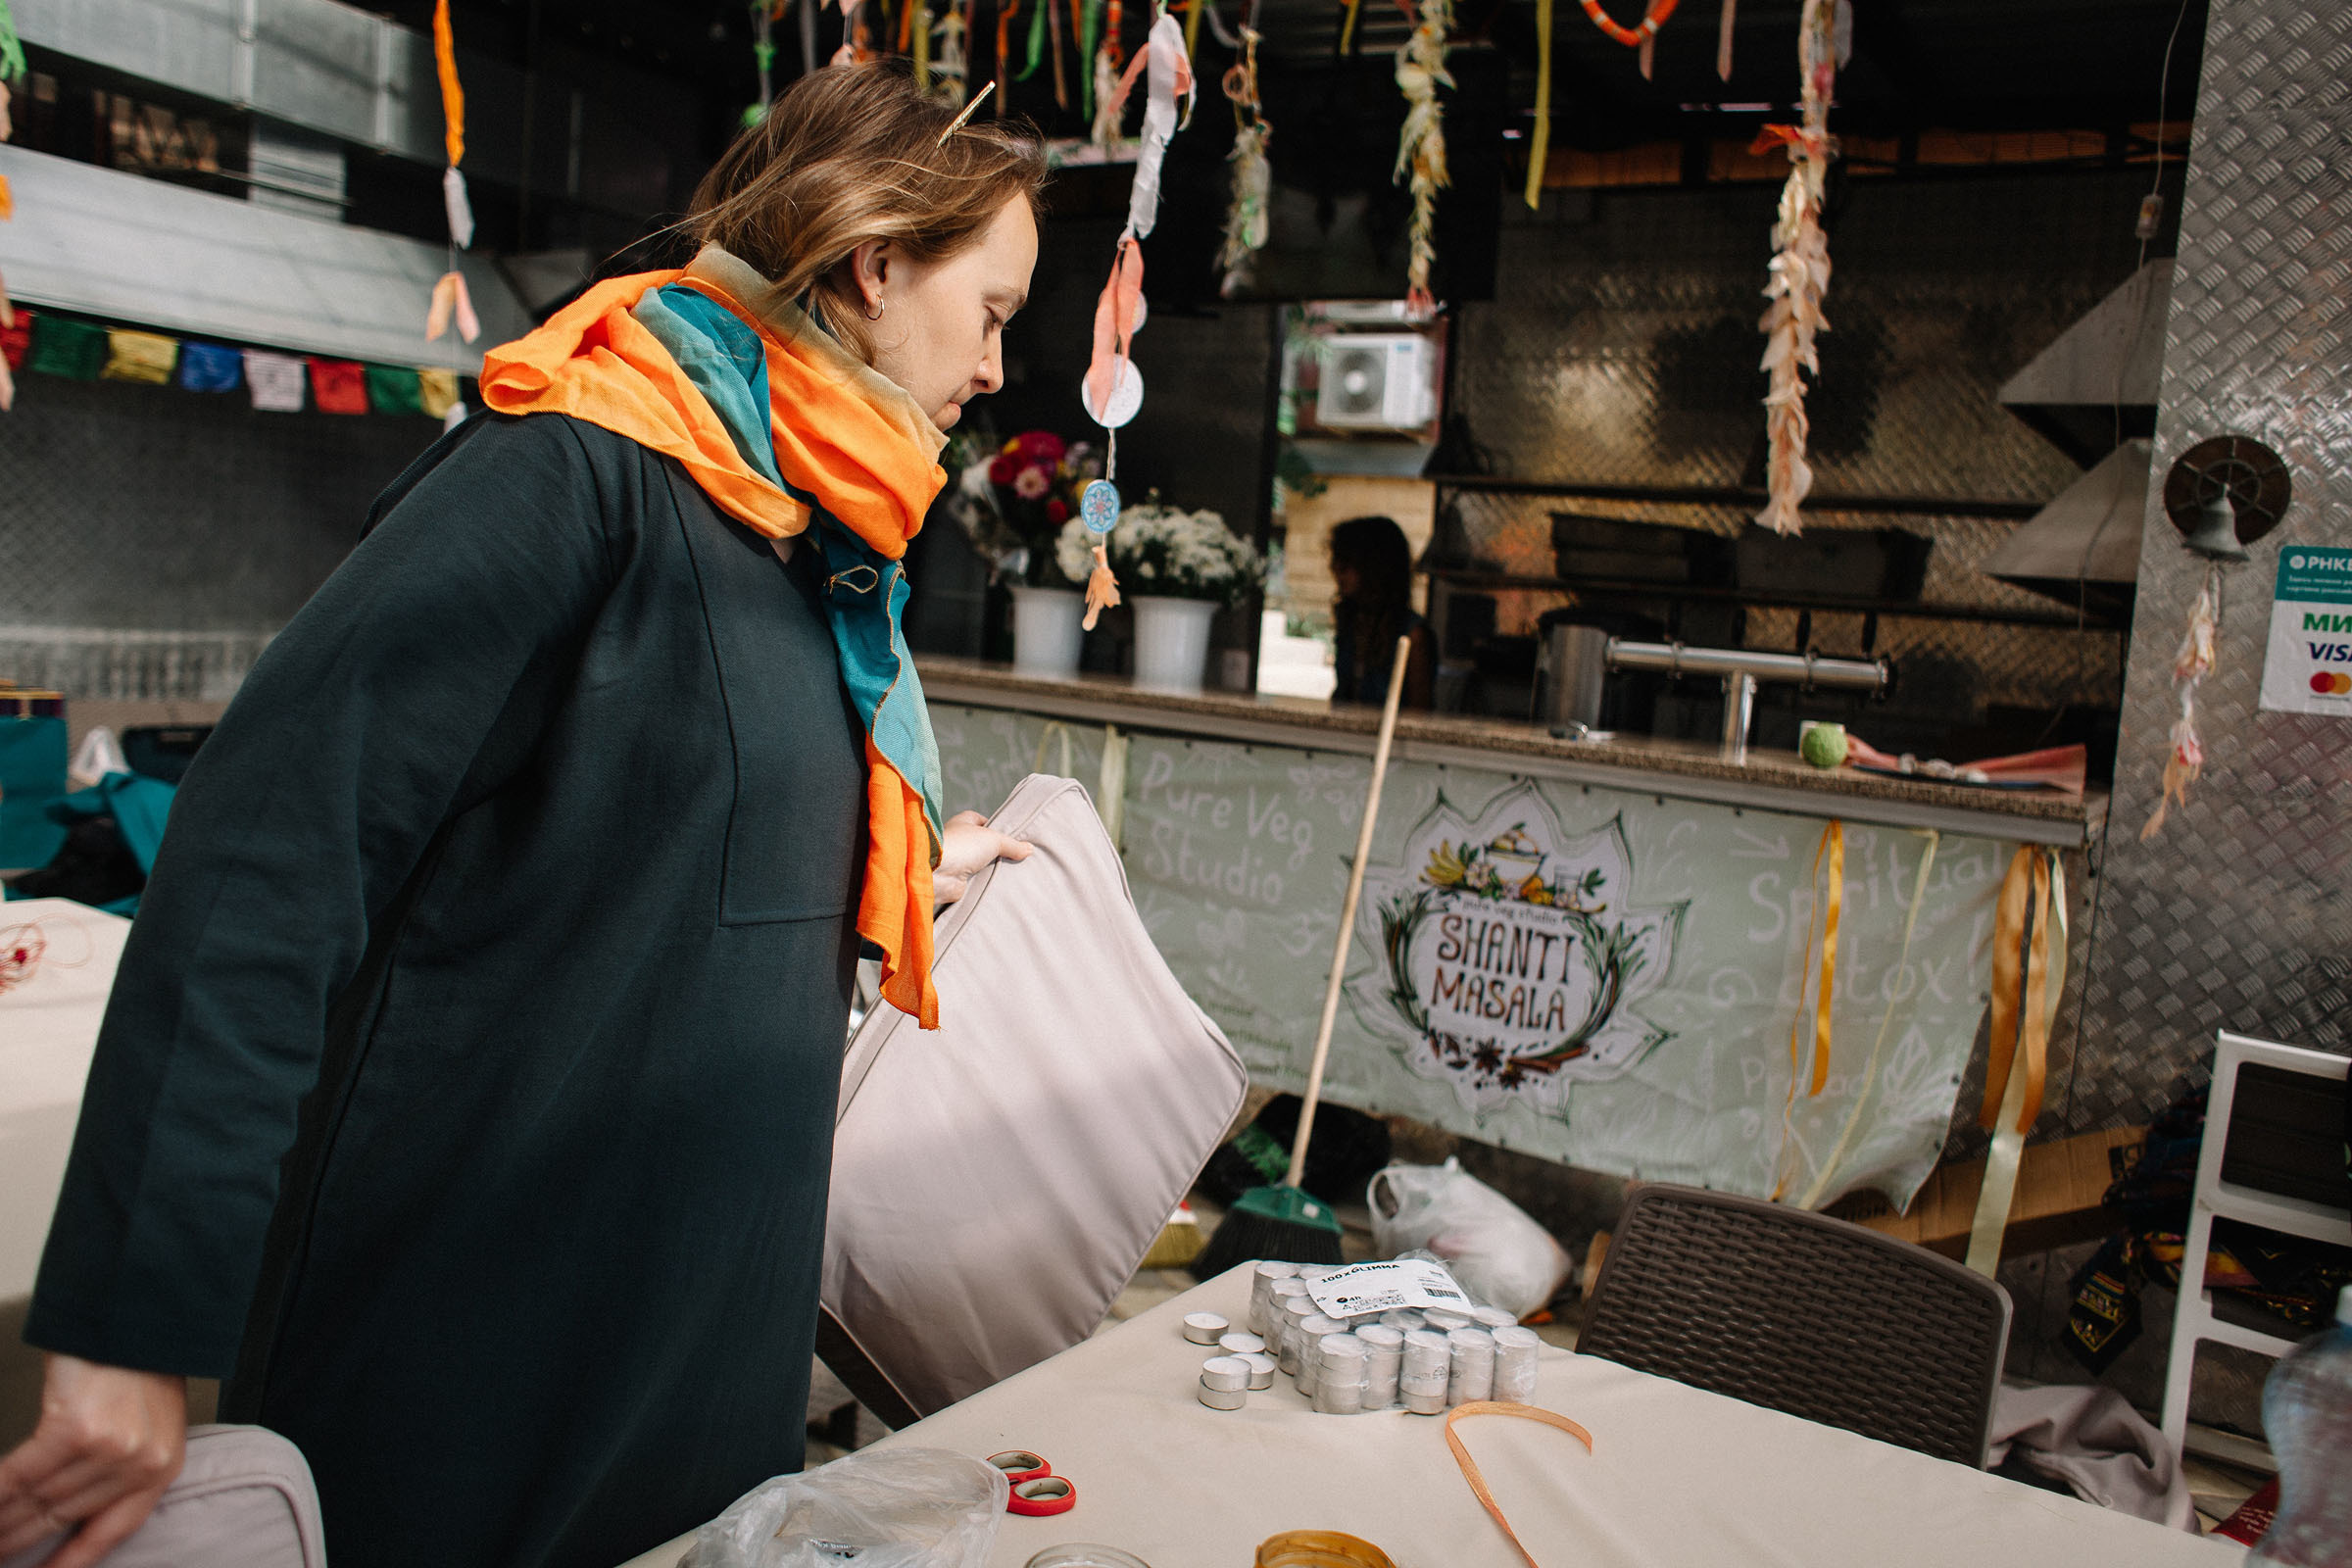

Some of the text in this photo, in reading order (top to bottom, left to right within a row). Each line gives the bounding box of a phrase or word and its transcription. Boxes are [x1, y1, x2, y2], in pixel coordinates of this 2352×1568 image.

[2307, 642, 2352, 662] VIS
[1141, 752, 1314, 871] Pure Veg
[1145, 818, 1284, 905] Studio
[1437, 914, 1576, 984] SHANTI
[1432, 965, 1566, 1031] MASALA
